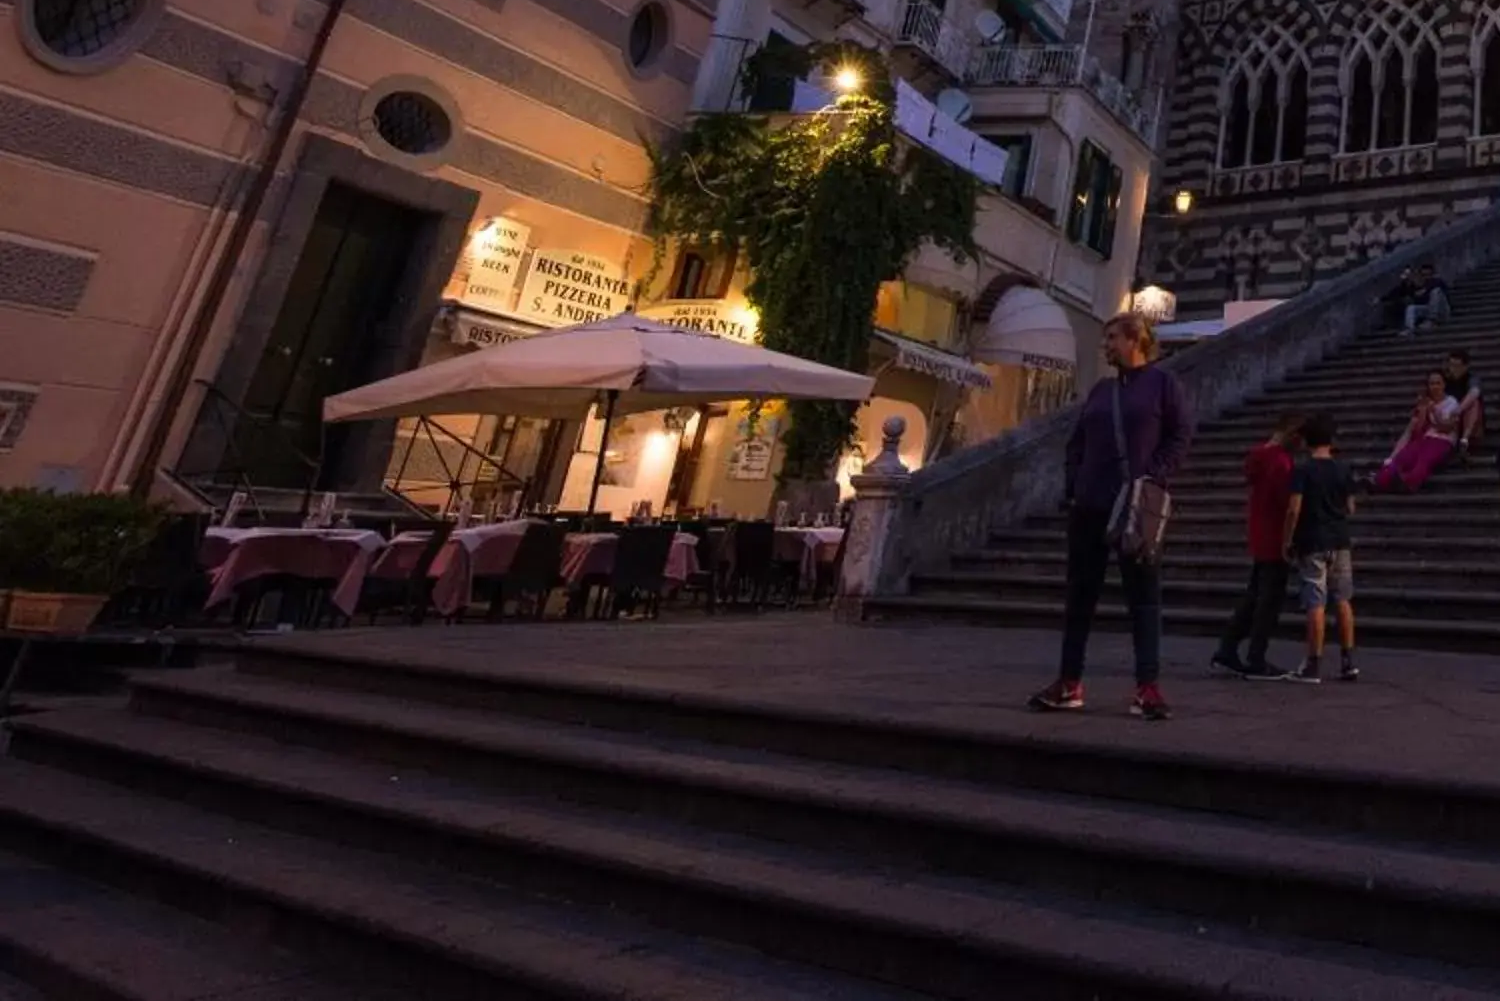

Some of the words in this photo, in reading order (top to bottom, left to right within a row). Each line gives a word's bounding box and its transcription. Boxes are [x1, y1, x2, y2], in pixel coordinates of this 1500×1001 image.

[536, 258, 629, 296] RISTORANTE
[531, 296, 546, 313] S.
[551, 302, 612, 324] ANDRE
[543, 280, 612, 312] PIZZERIA
